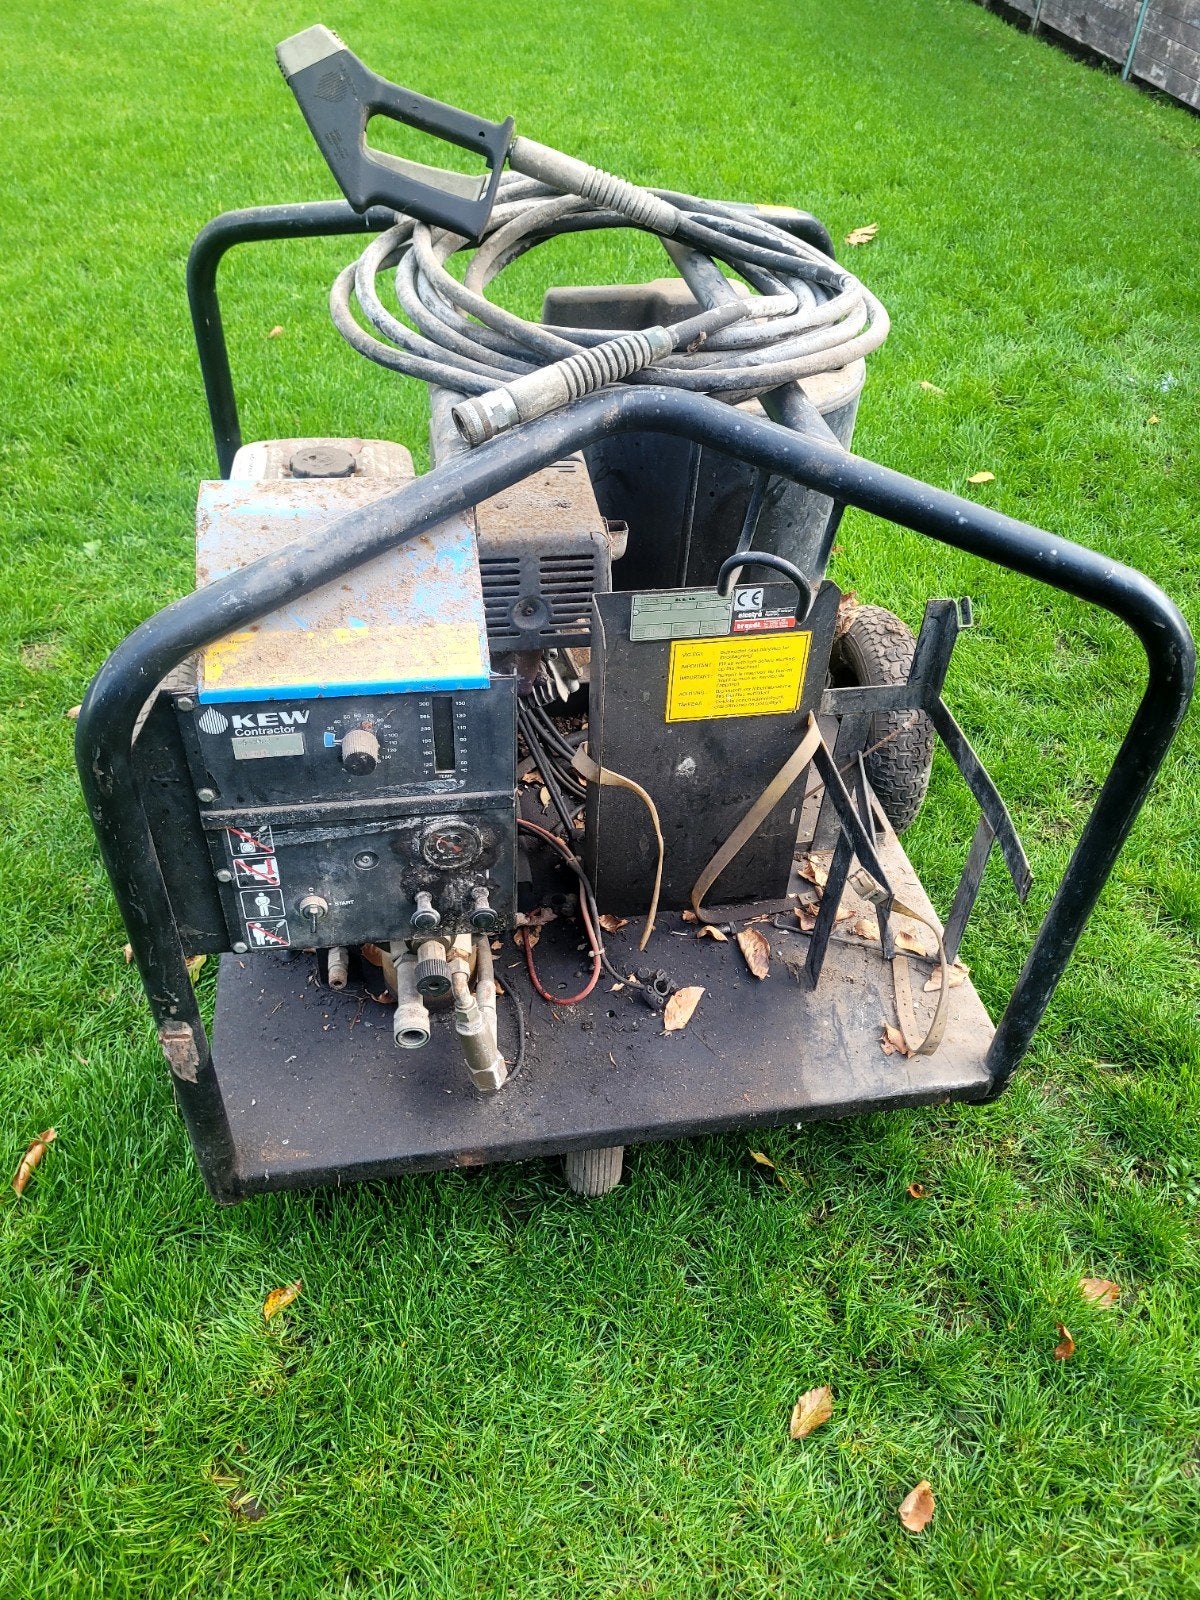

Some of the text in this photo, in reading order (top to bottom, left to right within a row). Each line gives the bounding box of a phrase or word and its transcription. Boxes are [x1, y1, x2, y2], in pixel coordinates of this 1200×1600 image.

[231, 709, 310, 729] KEW
[234, 726, 296, 737] Contractor
[334, 899, 355, 907] START
